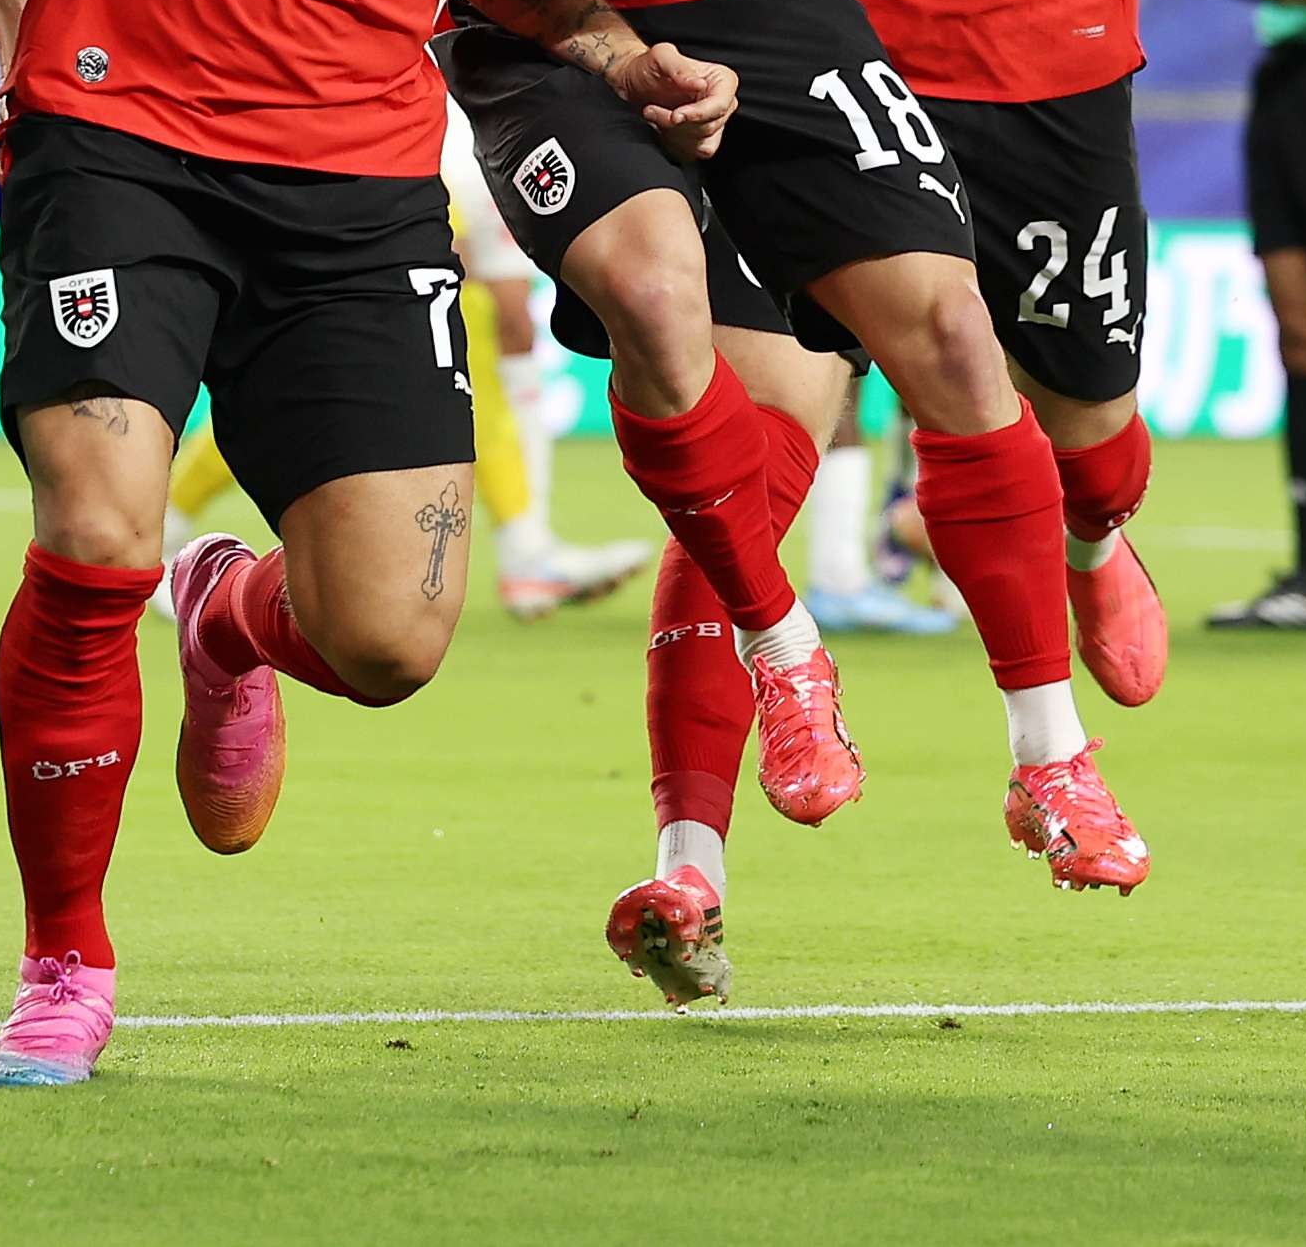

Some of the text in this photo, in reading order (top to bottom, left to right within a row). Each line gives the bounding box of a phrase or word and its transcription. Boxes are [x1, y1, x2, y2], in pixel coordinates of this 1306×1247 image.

[809, 60, 946, 172] 18
[408, 268, 459, 368] 7
[1017, 206, 1131, 329] 24
[32, 750, 122, 781] ÖFB
